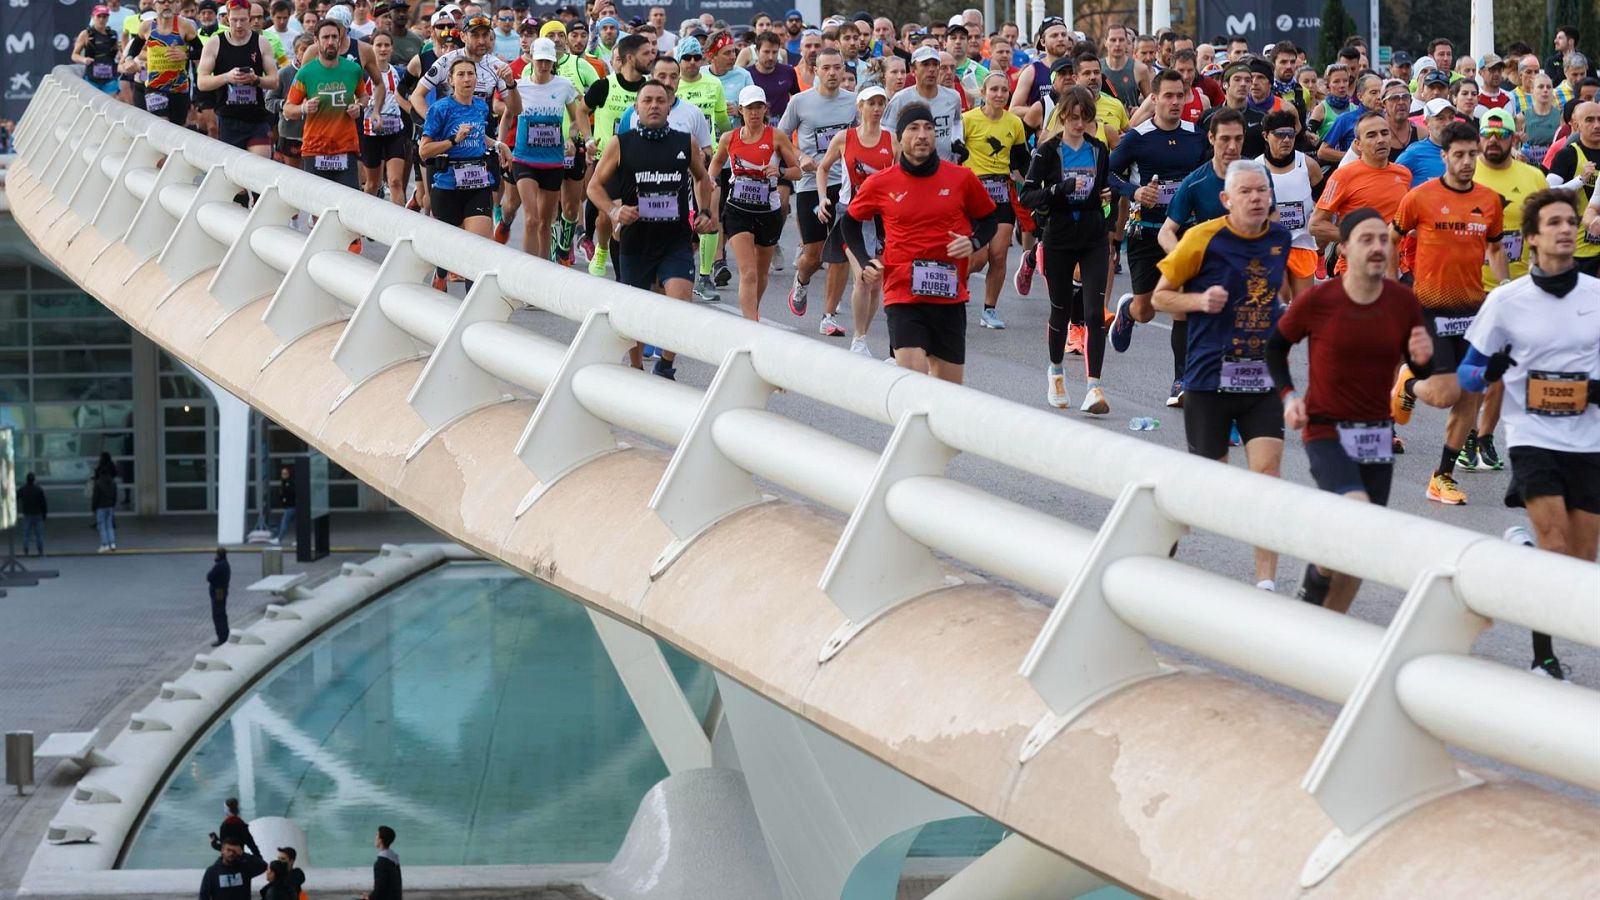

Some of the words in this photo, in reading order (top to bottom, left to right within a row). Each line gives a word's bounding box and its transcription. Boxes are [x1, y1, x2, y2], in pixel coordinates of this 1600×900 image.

[718, 0, 754, 9] balance
[319, 160, 343, 168] BENITO
[634, 170, 682, 185] Villalpardo
[742, 185, 761, 193] 18662
[739, 191, 762, 201] HELEN
[1434, 221, 1466, 231] NEVER
[1467, 222, 1487, 232] STOP
[924, 271, 949, 282] 16393
[1230, 376, 1265, 388] Claude
[1543, 386, 1575, 397] 15202
[1539, 398, 1577, 411] Jaume
